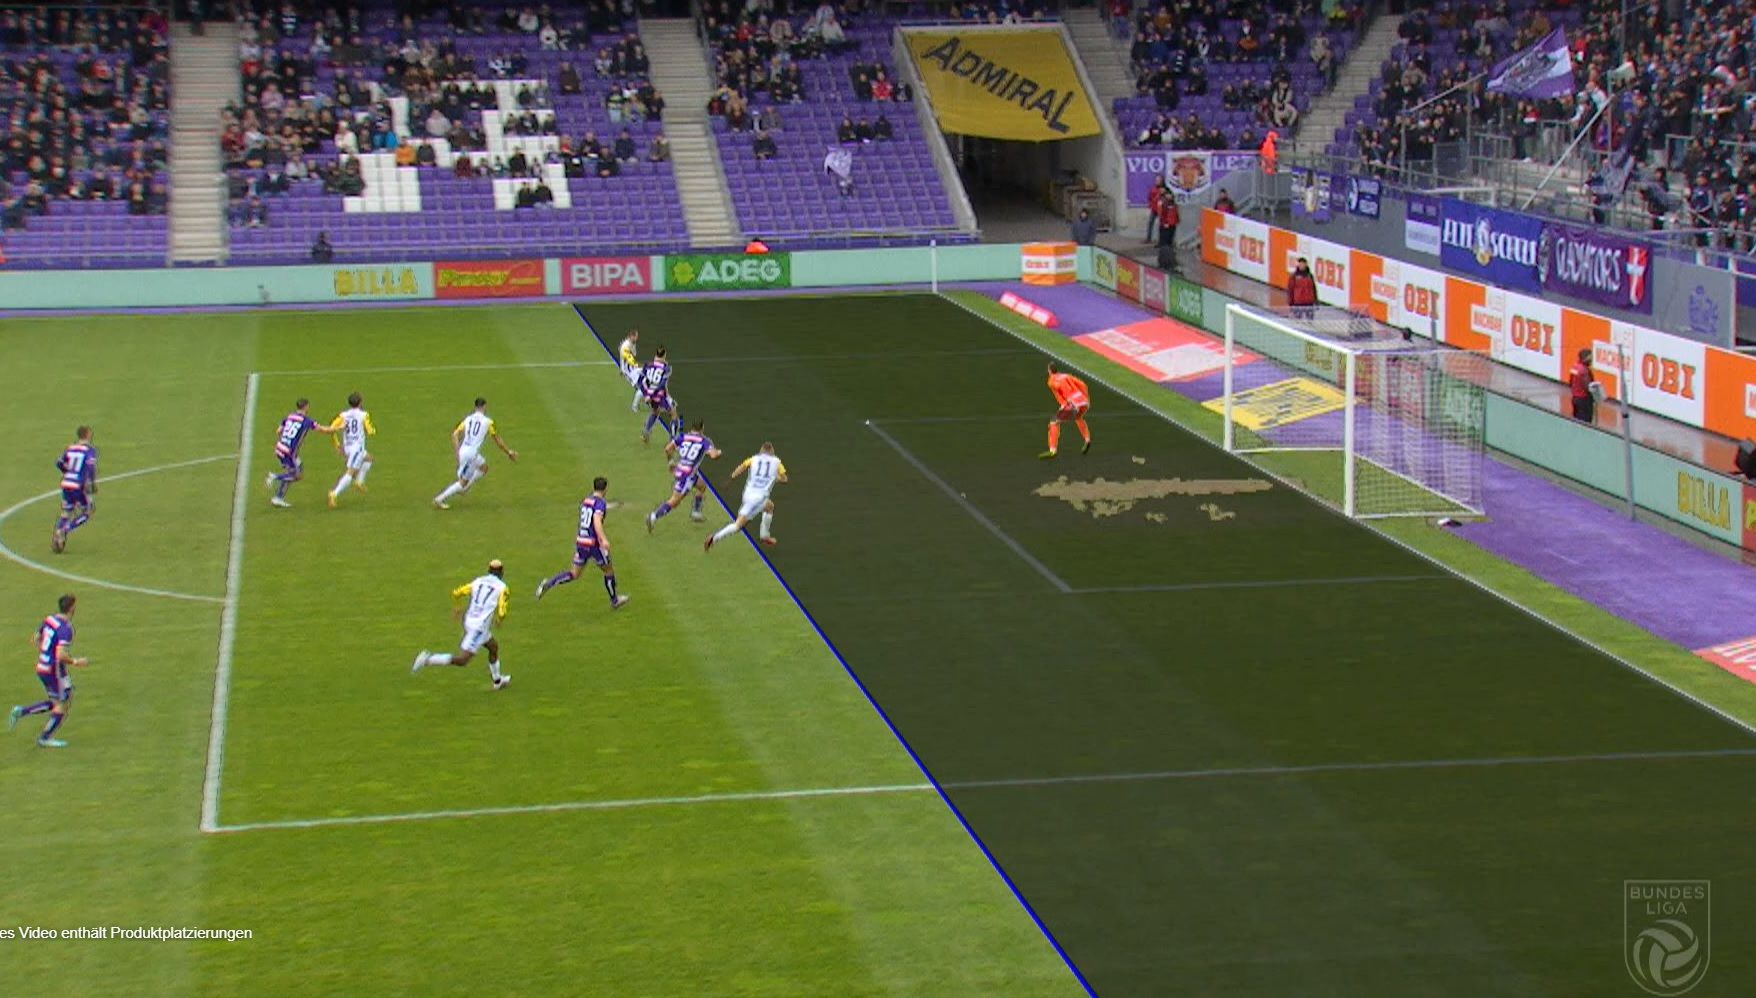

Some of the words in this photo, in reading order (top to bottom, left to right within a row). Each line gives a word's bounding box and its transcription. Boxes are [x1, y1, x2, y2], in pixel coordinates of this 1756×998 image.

[920, 36, 1074, 134] ADMIRAL
[1127, 157, 1165, 173] VIO
[1239, 234, 1265, 265] OBI
[334, 268, 418, 296] BILLA
[570, 262, 643, 289] BIPA
[698, 259, 781, 283] ADEG
[1315, 256, 1345, 290] OBI
[1404, 283, 1440, 320] OBI
[1511, 315, 1554, 356] OBI
[1641, 353, 1696, 400] OBI
[467, 420, 481, 436] 10
[756, 460, 771, 479] 11
[1678, 471, 1731, 530] BILLA
[580, 506, 594, 529] 20
[474, 583, 496, 604] 17
